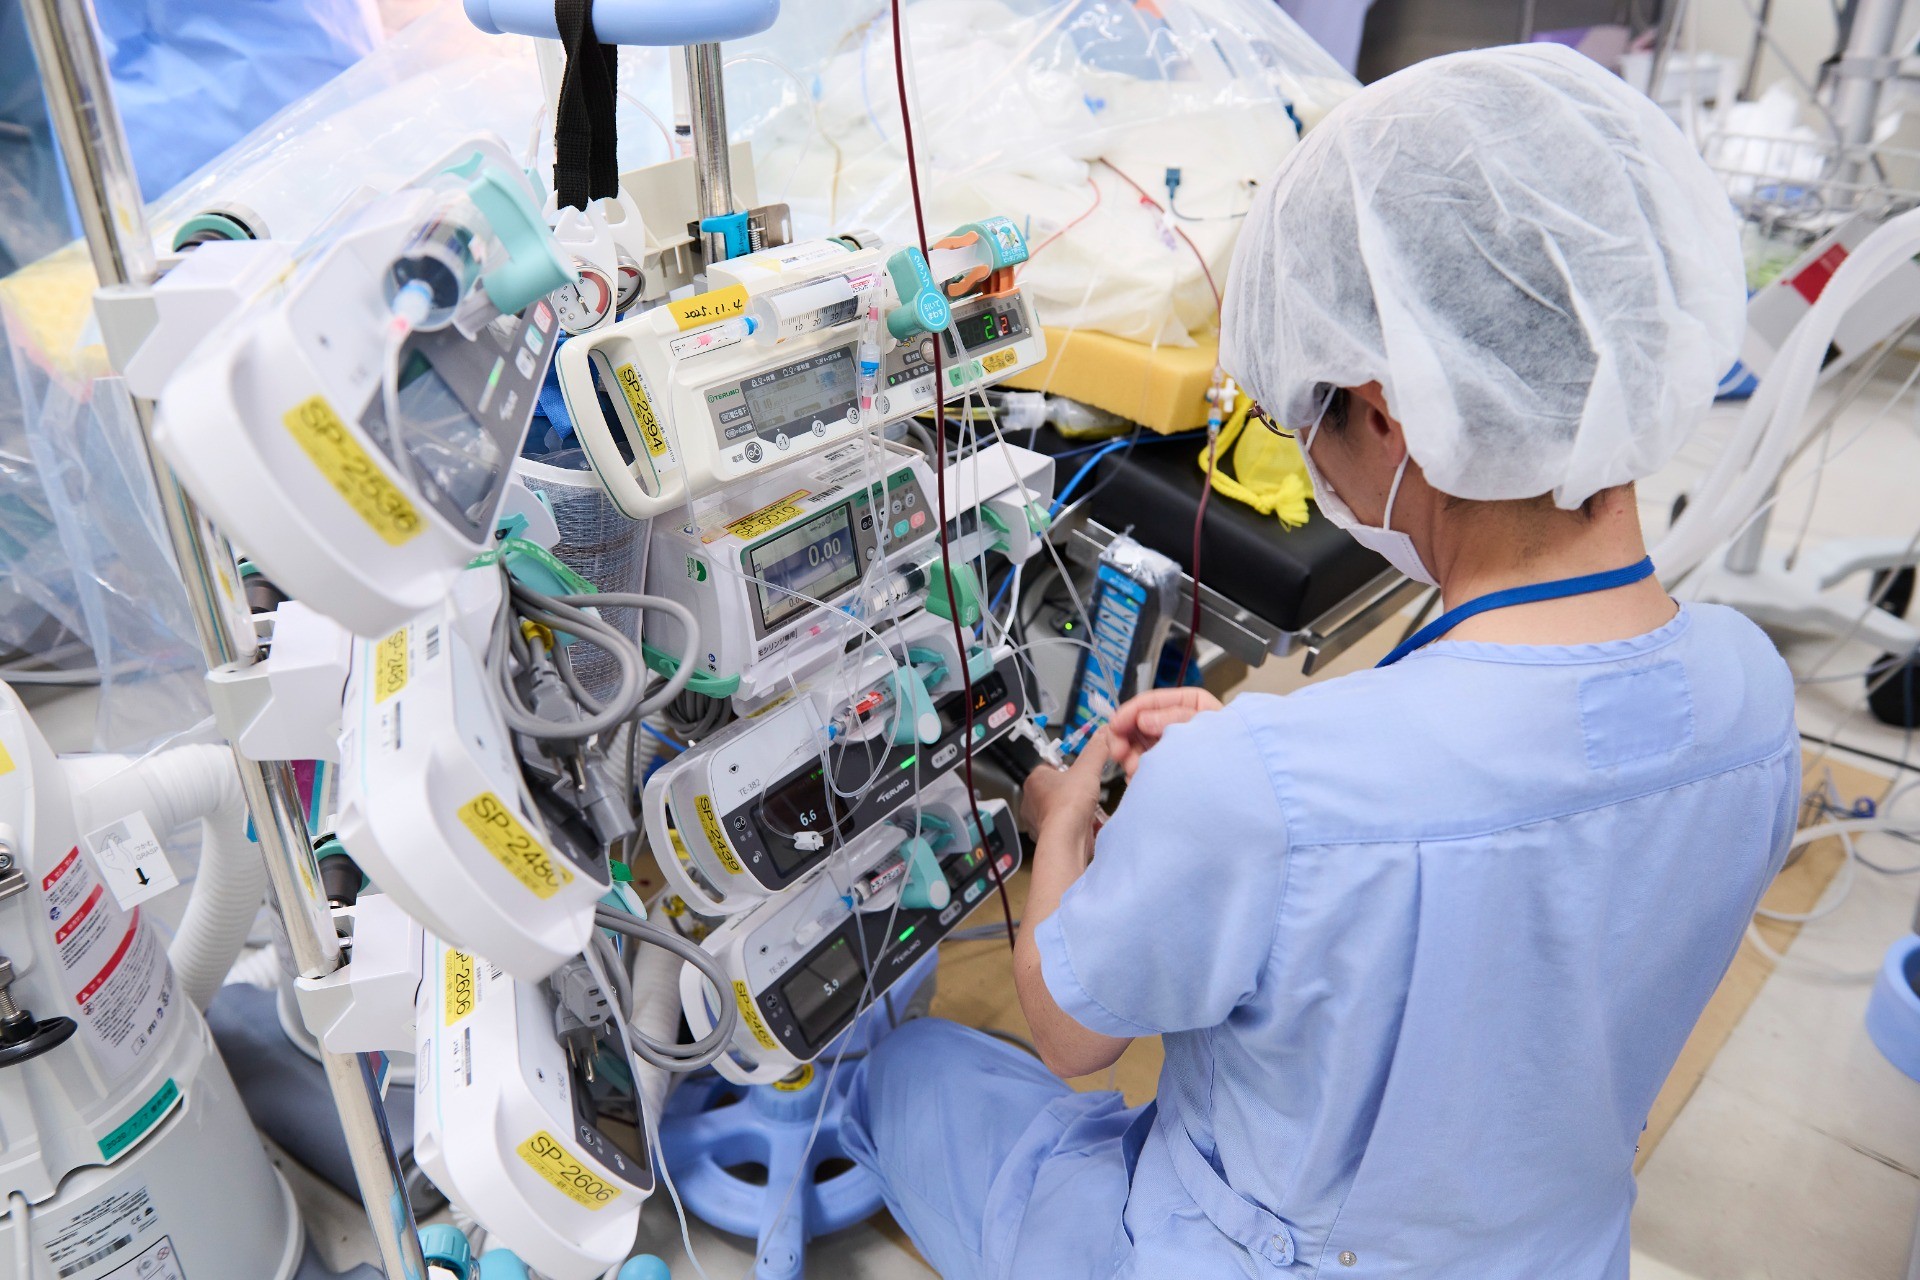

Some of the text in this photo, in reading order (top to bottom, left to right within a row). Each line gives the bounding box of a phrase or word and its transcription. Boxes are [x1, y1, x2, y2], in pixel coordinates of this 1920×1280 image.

[684, 298, 743, 319] 2025.11.4
[713, 388, 740, 401] TERUMO
[623, 368, 663, 451] SP-2394
[808, 537, 841, 567] 0.00
[738, 778, 762, 798] TE-382
[880, 778, 910, 803] TERUMO
[799, 808, 817, 827] 6.6
[699, 796, 741, 872] SP-2439
[135, 846, 159, 861] GRASP
[823, 977, 840, 997] 5.9
[530, 1135, 615, 1202] SP-2606
